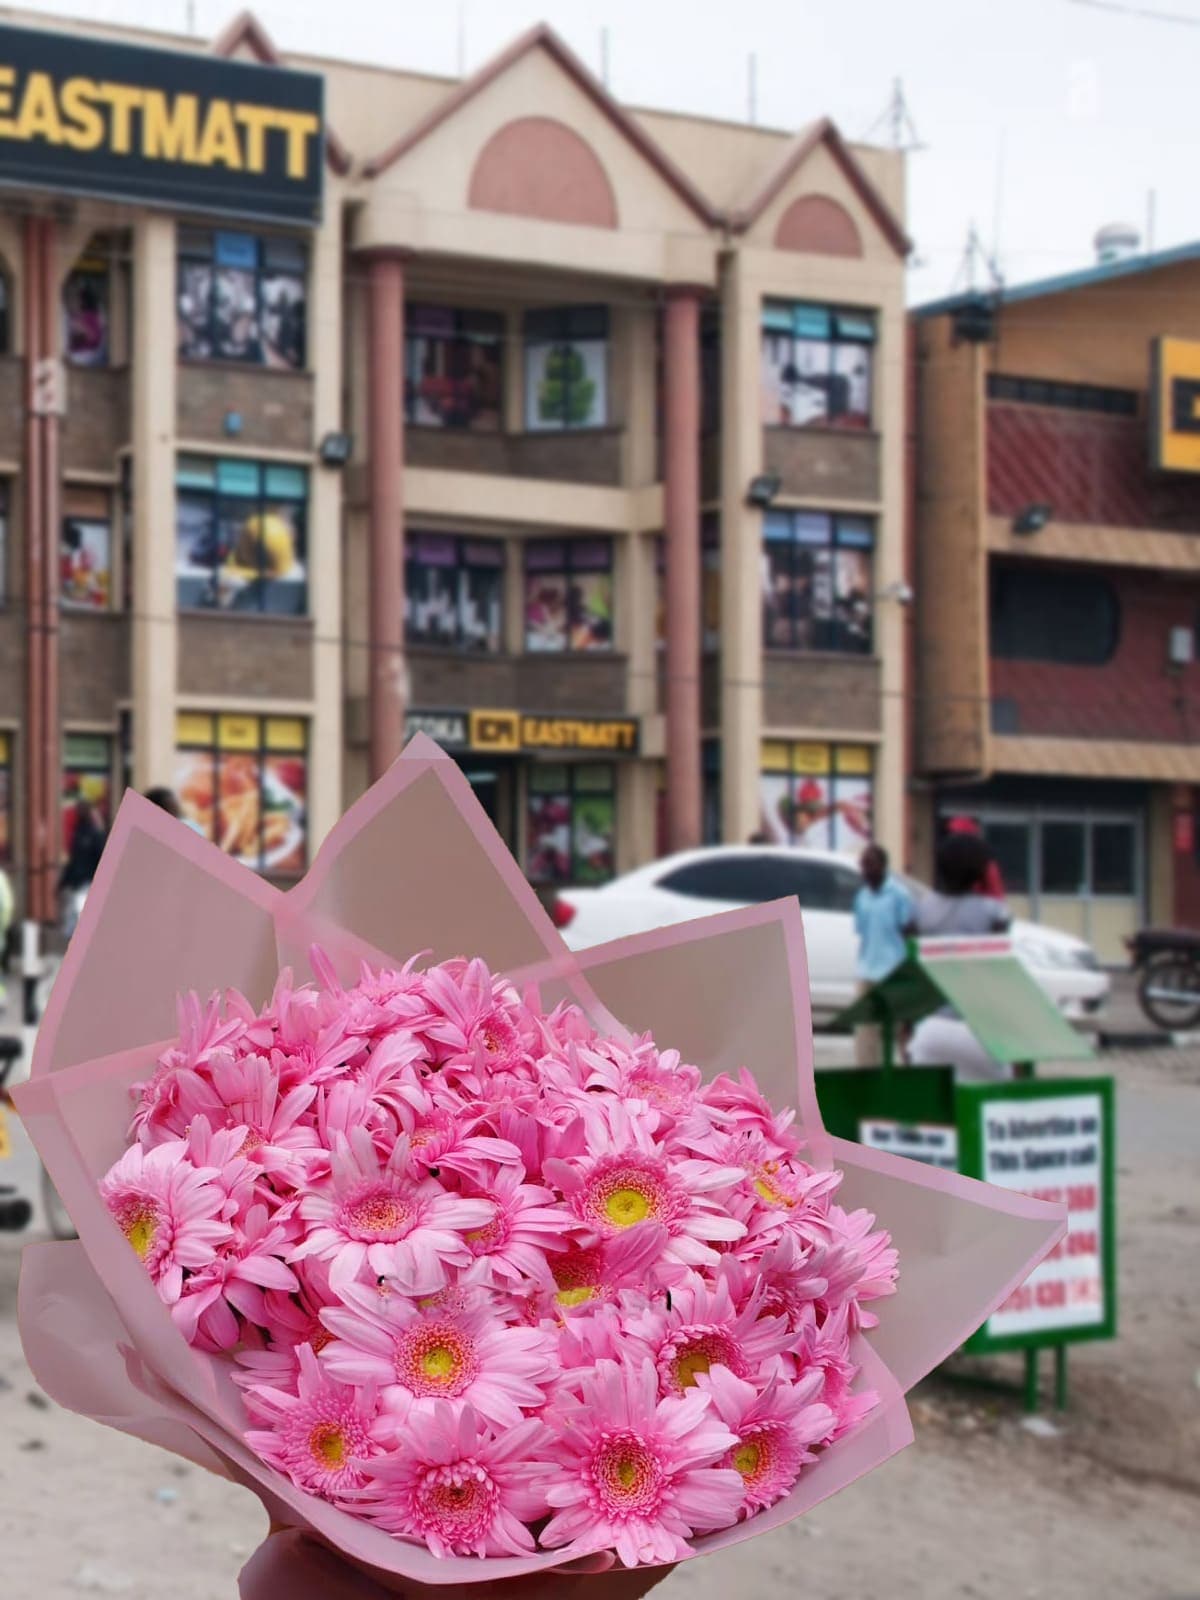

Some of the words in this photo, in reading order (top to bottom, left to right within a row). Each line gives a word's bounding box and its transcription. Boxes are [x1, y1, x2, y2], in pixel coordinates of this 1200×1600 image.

[0, 65, 318, 179] EASTMATT
[523, 717, 635, 749] EASTMATT
[1008, 1116, 1075, 1140] Advertise
[989, 1150, 1019, 1171] This
[1023, 1148, 1067, 1171] Space
[1069, 1144, 1097, 1165] call
